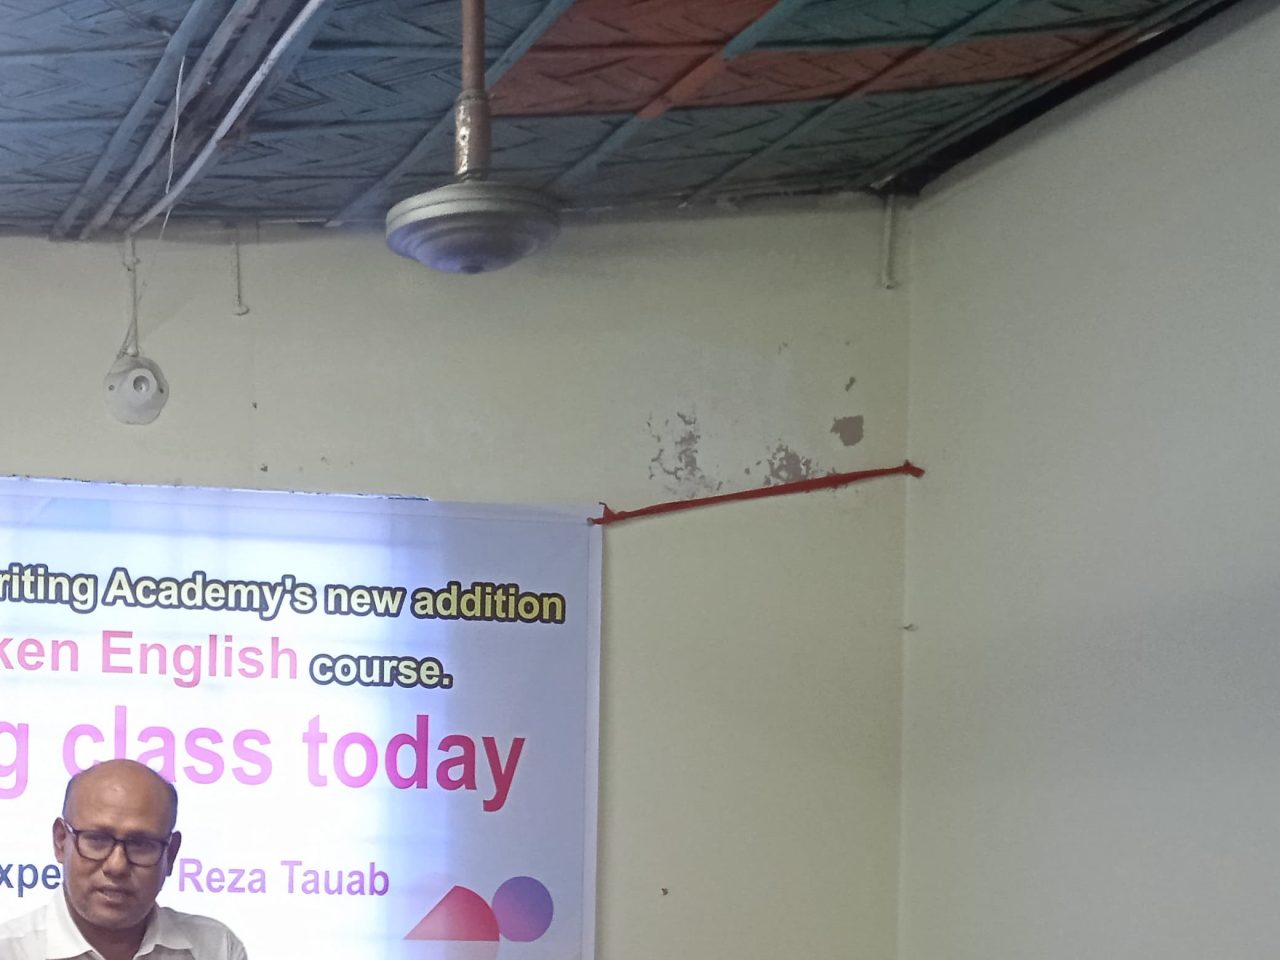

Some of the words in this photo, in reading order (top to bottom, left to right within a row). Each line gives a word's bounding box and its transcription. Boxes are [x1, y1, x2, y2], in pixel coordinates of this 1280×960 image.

[103, 567, 317, 620] Academy's
[323, 583, 406, 617] new
[411, 581, 567, 624] addition
[102, 630, 298, 688] English
[309, 654, 453, 690] course.
[62, 705, 273, 786] class
[302, 714, 527, 813] today
[178, 858, 267, 894] Reza
[280, 860, 390, 897] Tauab
